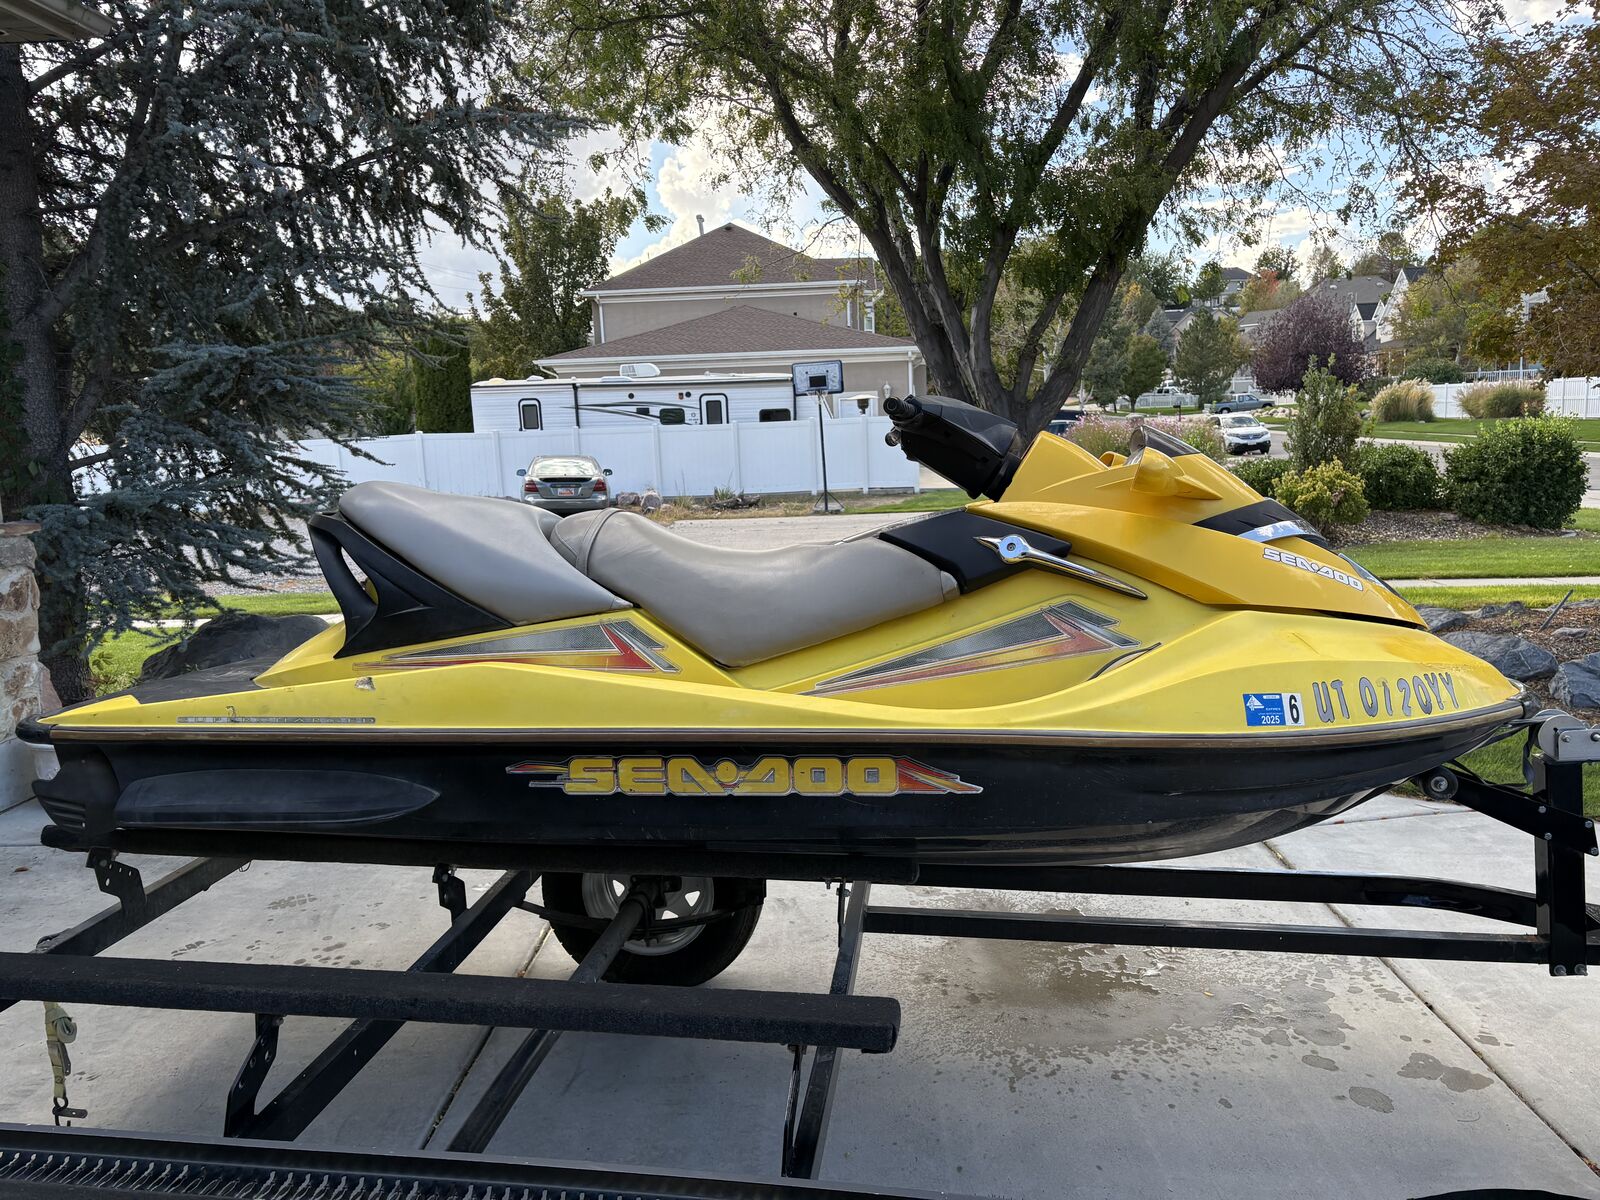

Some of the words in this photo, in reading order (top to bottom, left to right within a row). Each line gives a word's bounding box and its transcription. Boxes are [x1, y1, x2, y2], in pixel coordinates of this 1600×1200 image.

[1288, 694, 1300, 724] 6
[1311, 679, 1351, 723] UT
[1261, 715, 1280, 725] 2025
